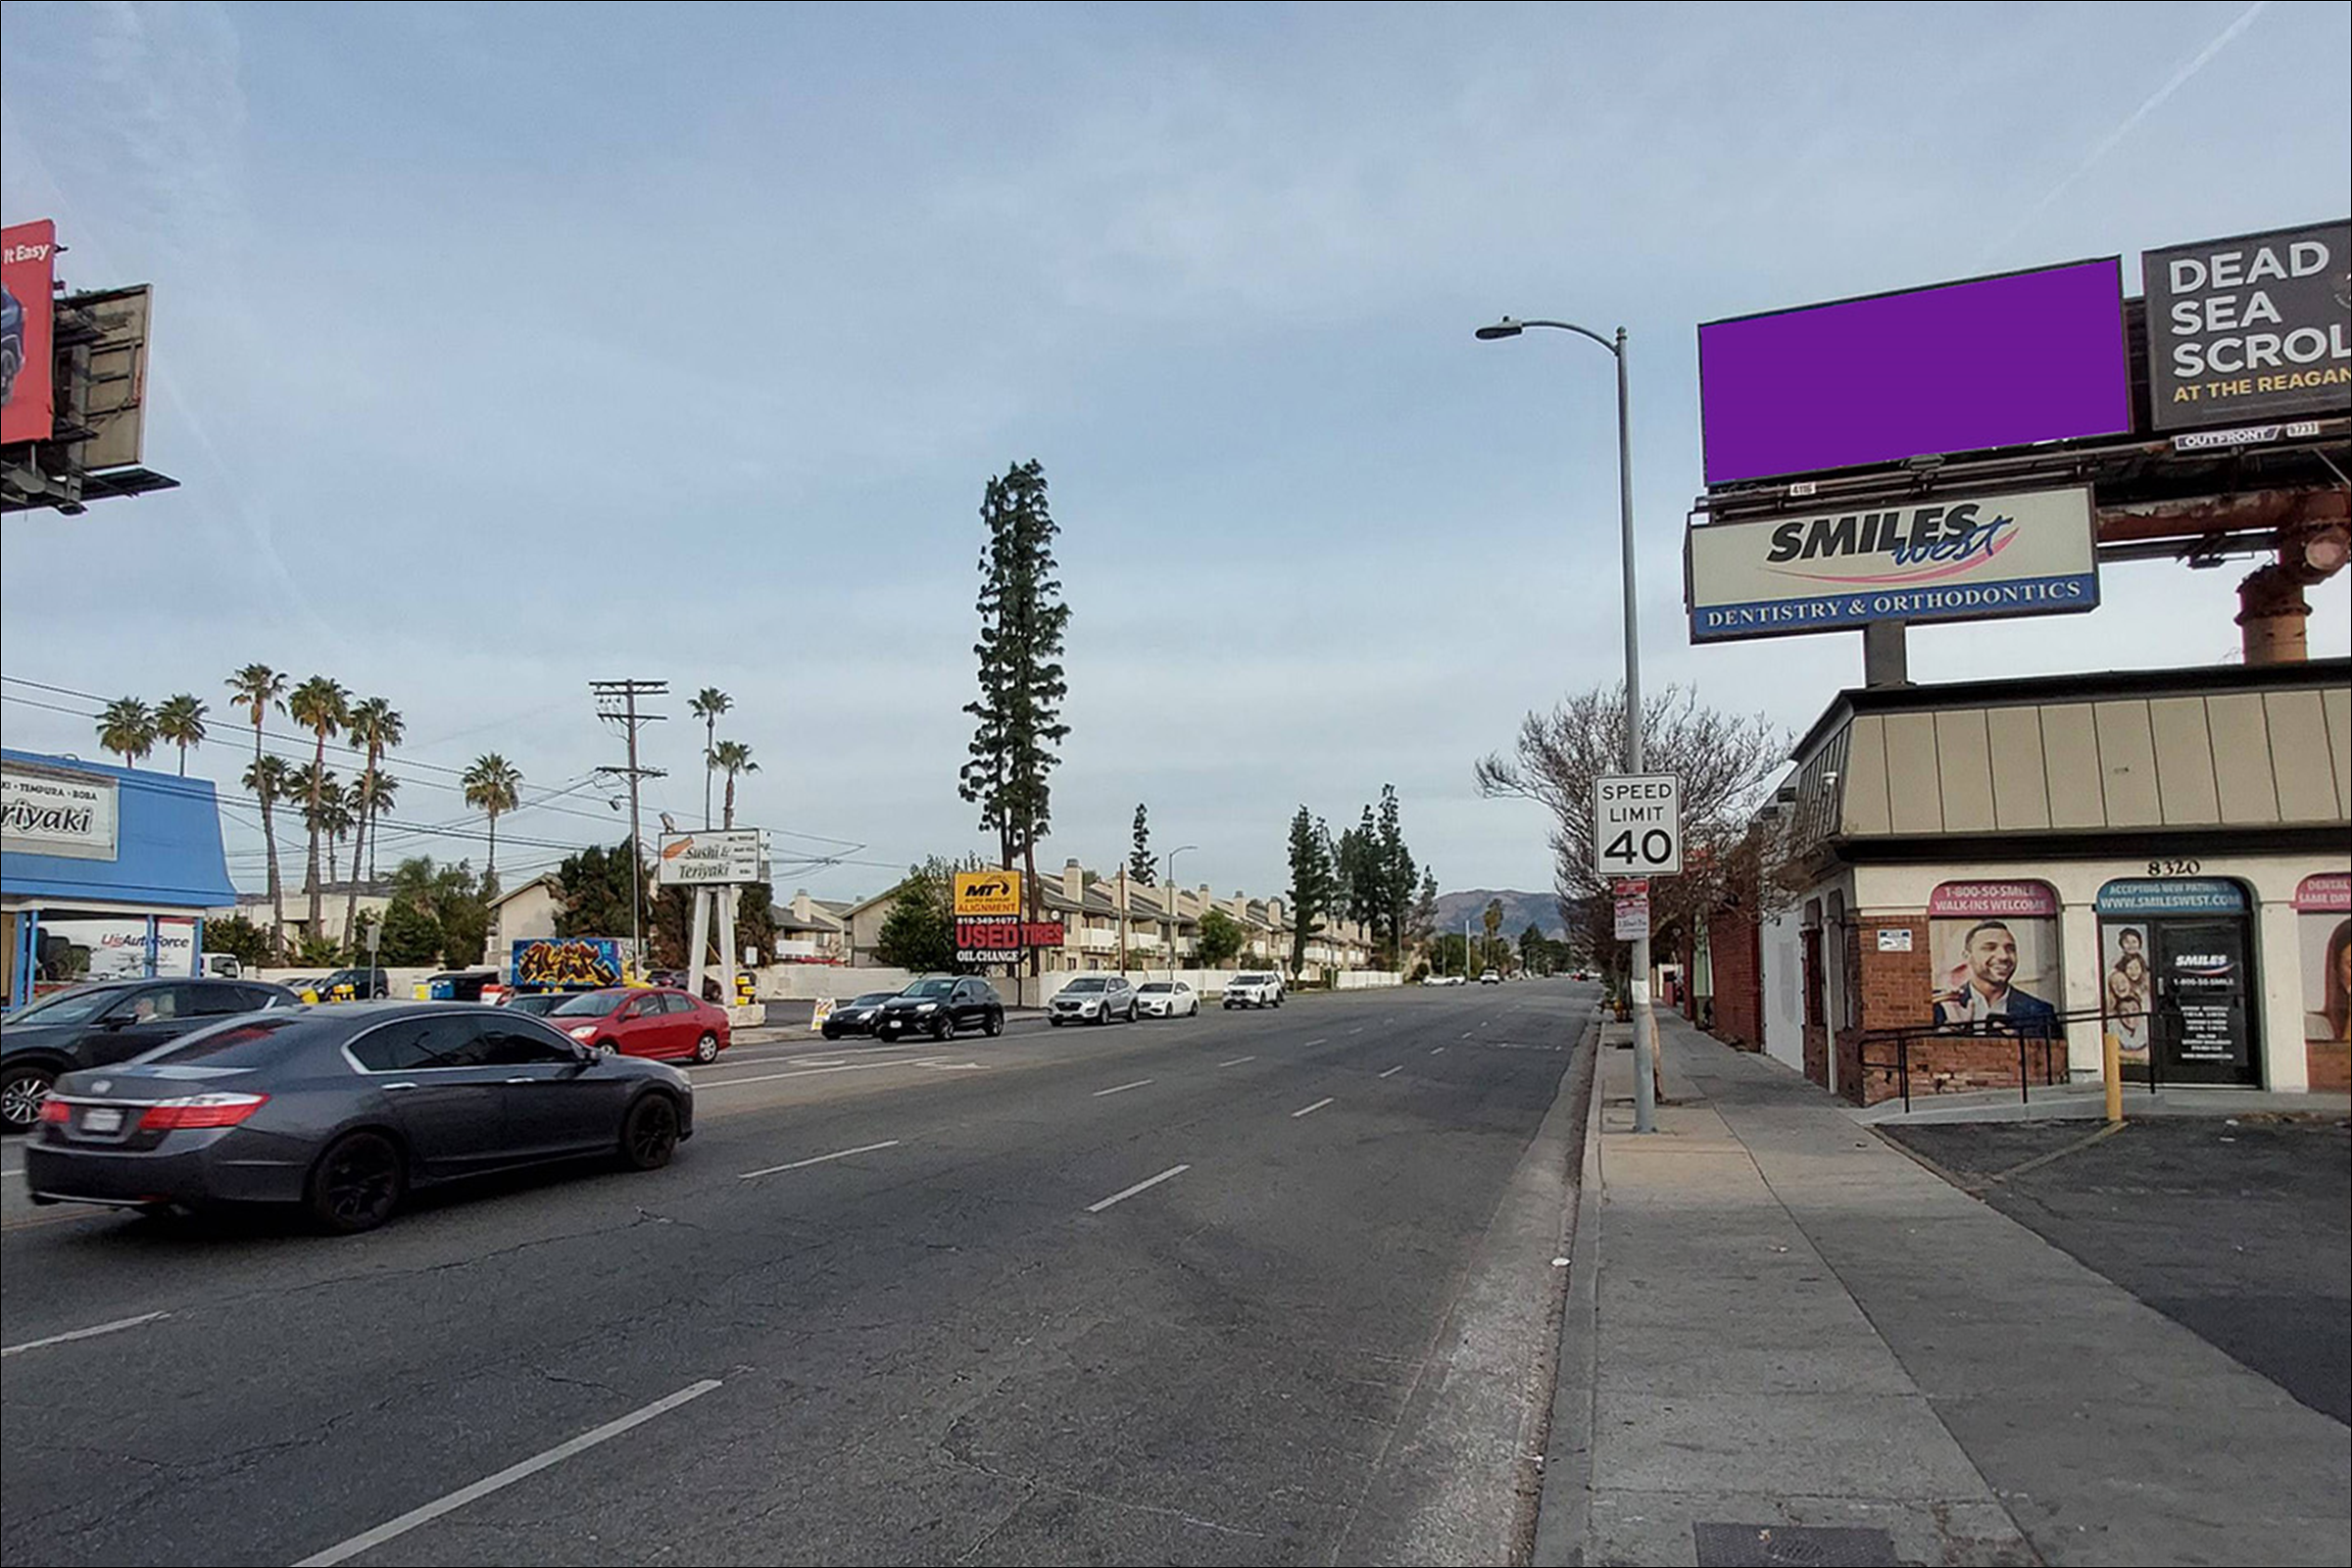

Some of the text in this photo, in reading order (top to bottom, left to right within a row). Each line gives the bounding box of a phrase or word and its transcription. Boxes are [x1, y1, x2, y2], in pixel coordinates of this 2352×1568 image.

[16, 243, 50, 262] Easy
[2169, 241, 2329, 294] DEAD
[2171, 291, 2282, 335] SEA
[2173, 324, 2351, 377] SCROL
[2173, 367, 2351, 403] AT THE REAGAN
[2184, 429, 2268, 447] OUTFRONT
[1766, 504, 1981, 563] SMILES
[1892, 514, 2013, 565] west
[1707, 580, 2081, 627] DENTISTRY & ORTHODONTICS
[20, 783, 65, 797] TEMPURA
[73, 790, 98, 801] BOBA
[1602, 784, 1672, 801] SPEED
[1610, 807, 1664, 822] LIMIT
[686, 844, 718, 859] Sushi
[720, 846, 730, 858] &
[1604, 829, 1672, 864] 40
[679, 862, 729, 879] Teriyaki
[2147, 859, 2201, 876] 8320
[965, 884, 1001, 897] MT
[957, 904, 1015, 912] ALIGNMENT
[1990, 900, 2047, 910] WELCOME
[2100, 895, 2242, 908] WWW.SMILESWEST.COM
[956, 923, 1063, 949] USED TIRES
[976, 950, 1019, 962] CHANGE
[2176, 955, 2227, 966] SMILES
